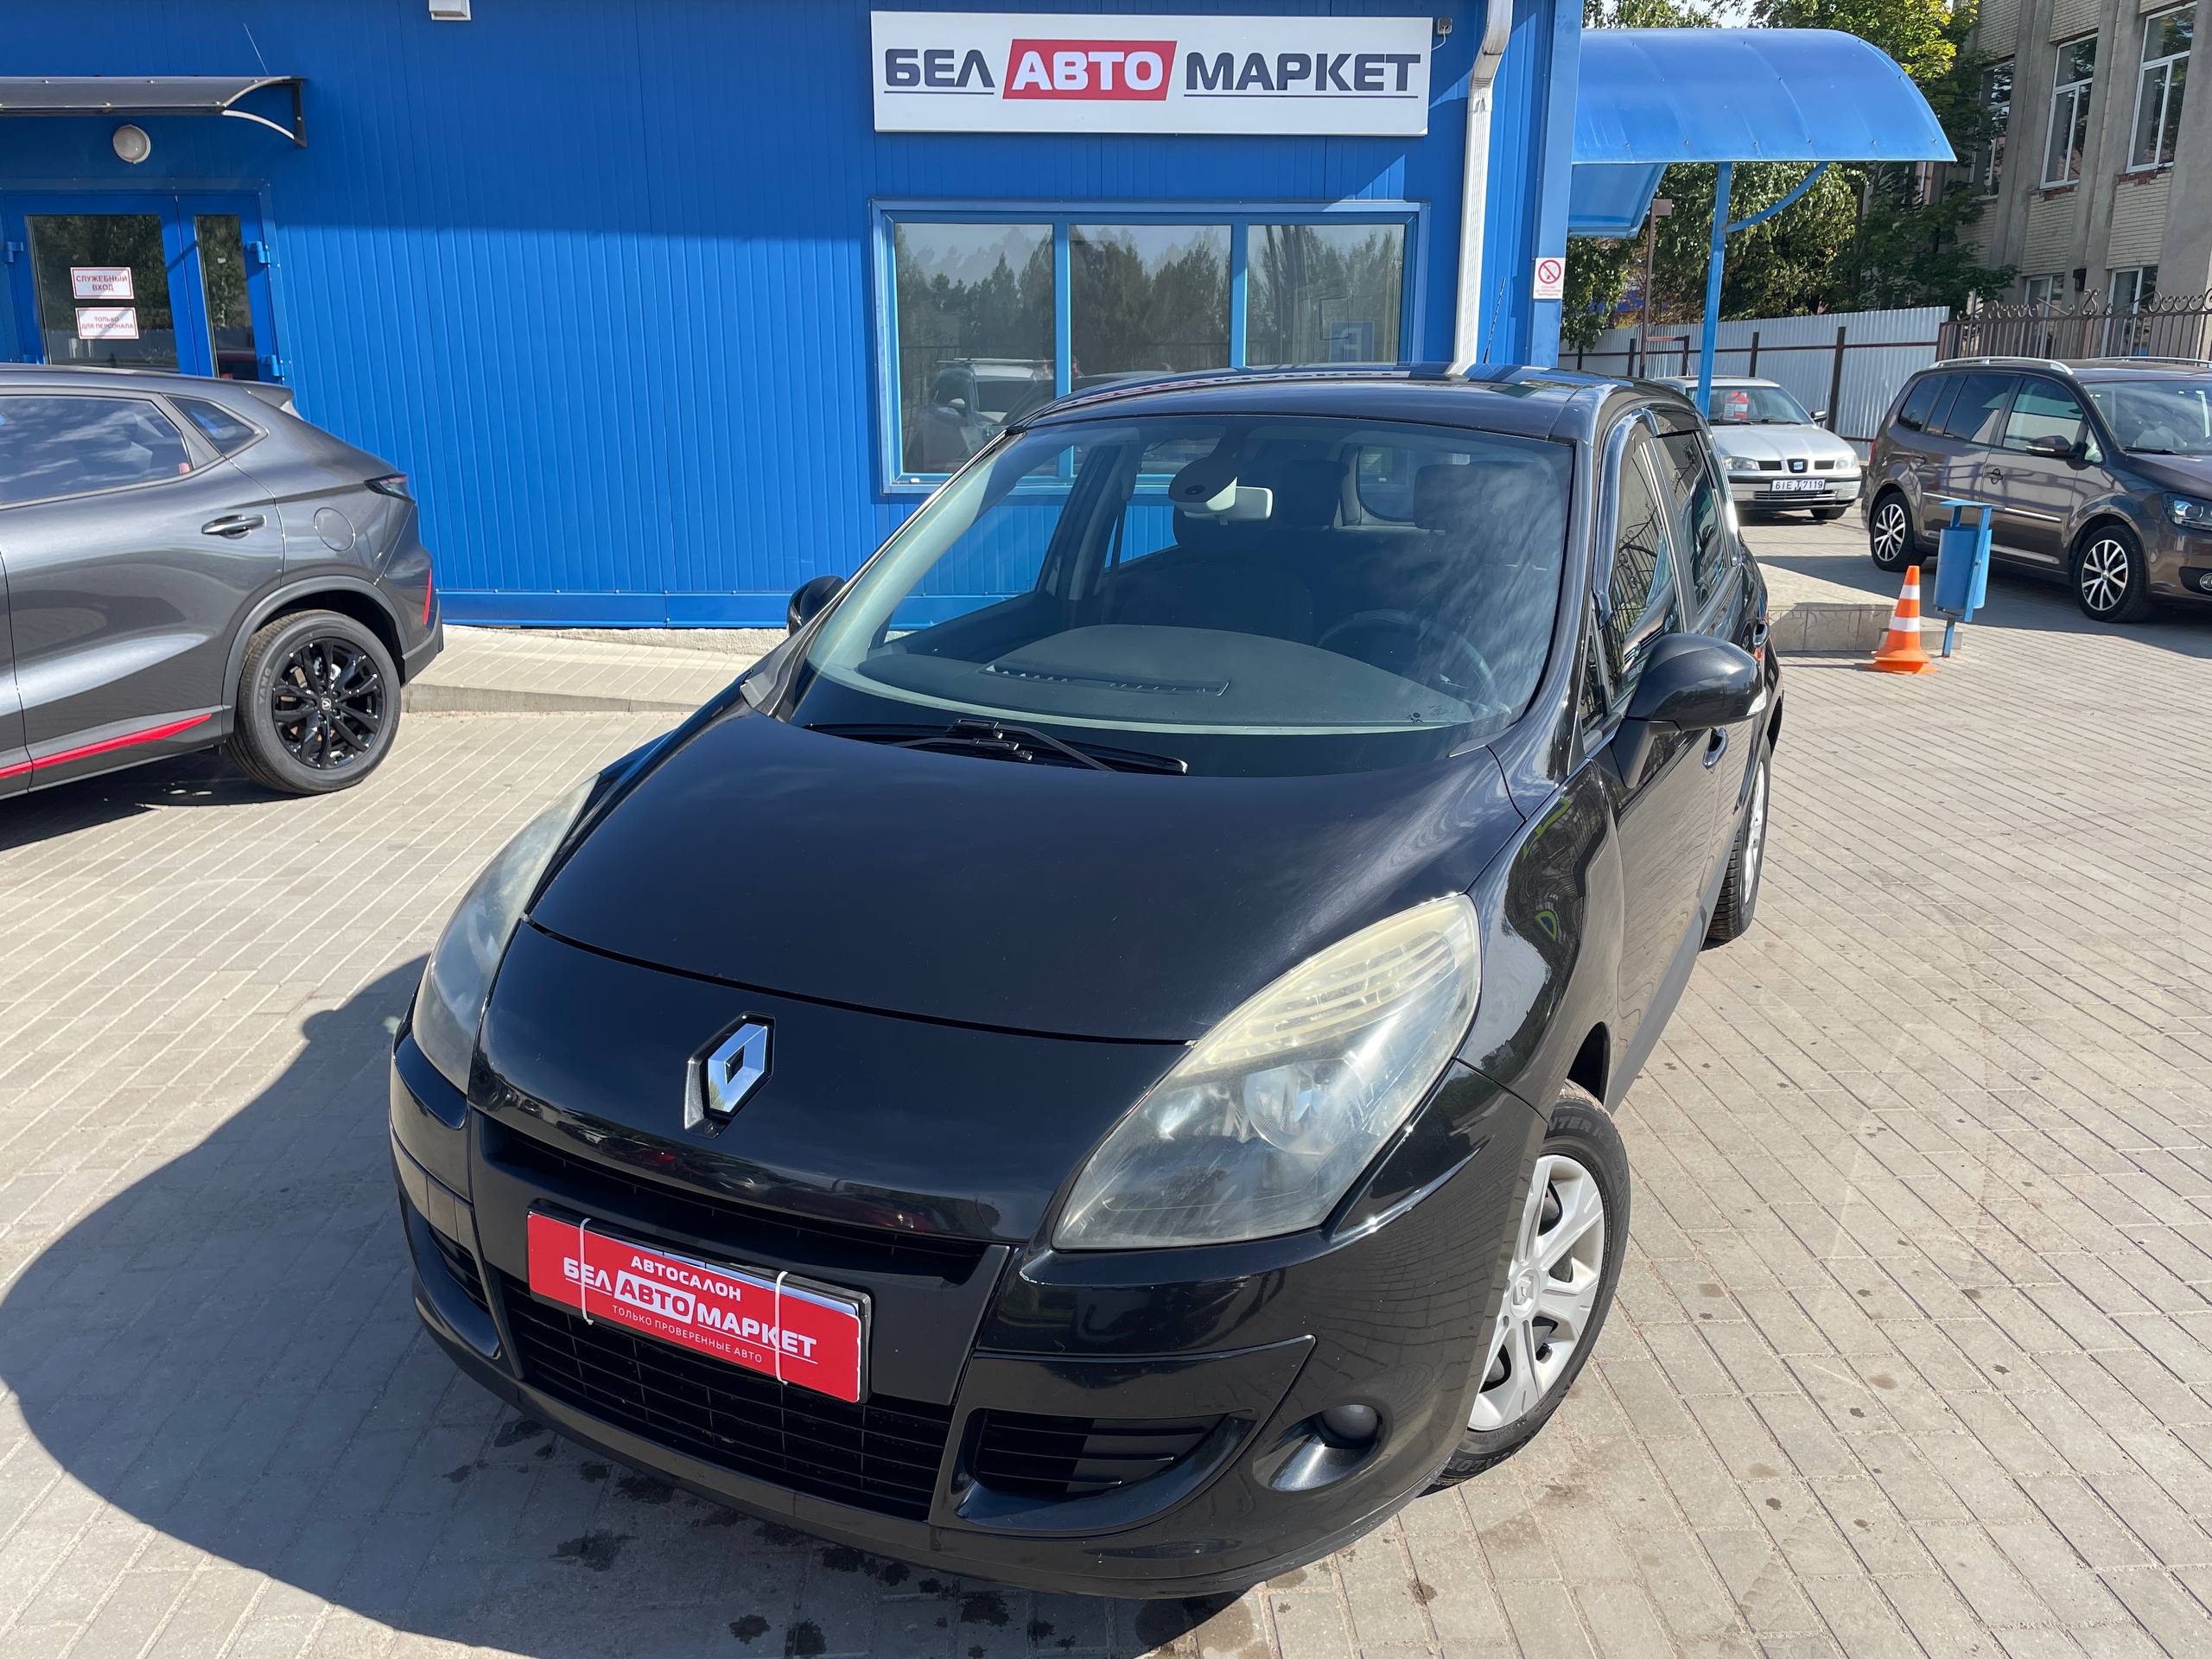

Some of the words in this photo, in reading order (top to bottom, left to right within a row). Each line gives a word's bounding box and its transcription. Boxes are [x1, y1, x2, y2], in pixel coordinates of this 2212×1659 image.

[885, 48, 995, 88] БЕЛ
[1010, 50, 1164, 92] АВТО
[1185, 51, 1421, 92] МАРКЕТ
[76, 274, 128, 283] СЛУЖЕБНЫЙ
[630, 1255, 742, 1302] АВТОСАЛОН
[563, 1256, 612, 1292] БЕЛ
[619, 1278, 691, 1316] АВТО
[697, 1303, 817, 1357] МАРКЕТ
[612, 1305, 652, 1327] ТОЛЬКО
[654, 1320, 731, 1353] ПРОВЕРЕННЫЕ
[734, 1347, 763, 1363] АВТО
